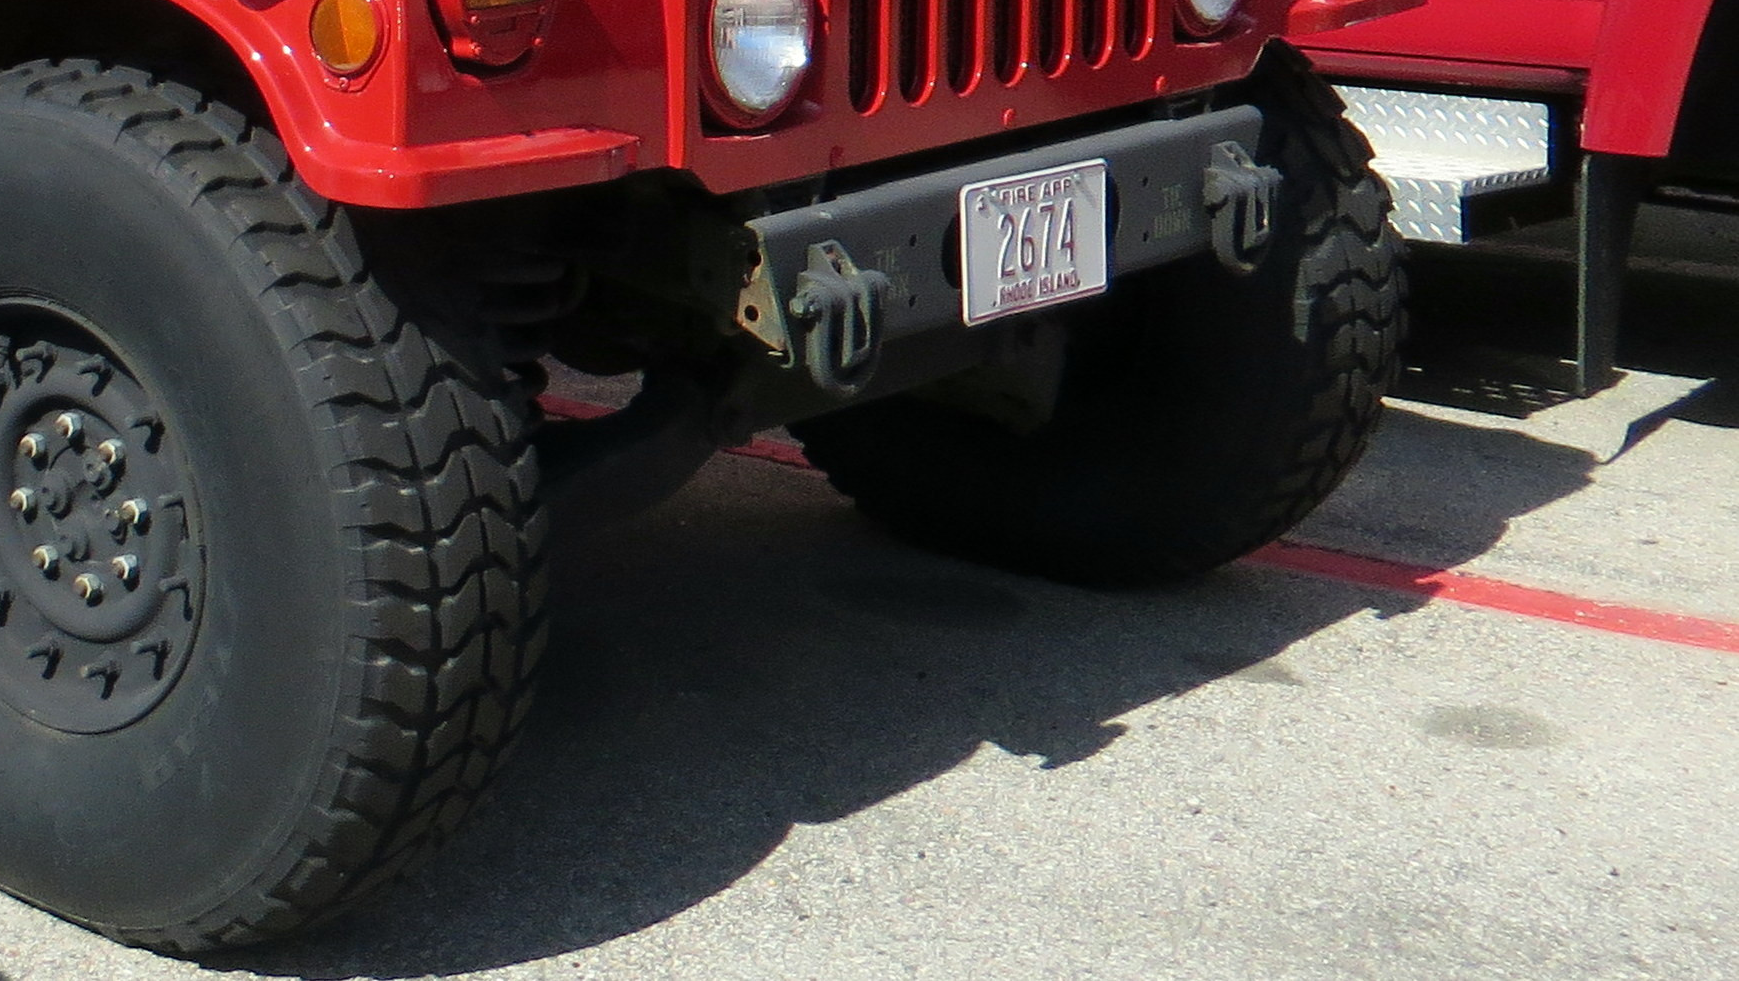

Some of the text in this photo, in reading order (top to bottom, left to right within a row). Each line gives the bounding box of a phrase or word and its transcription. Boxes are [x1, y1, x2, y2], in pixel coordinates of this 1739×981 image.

[999, 182, 1037, 206] FIRE
[1040, 175, 1073, 199] APP
[997, 197, 1076, 280] 2674
[995, 267, 1080, 308] RHODE ISLAND
